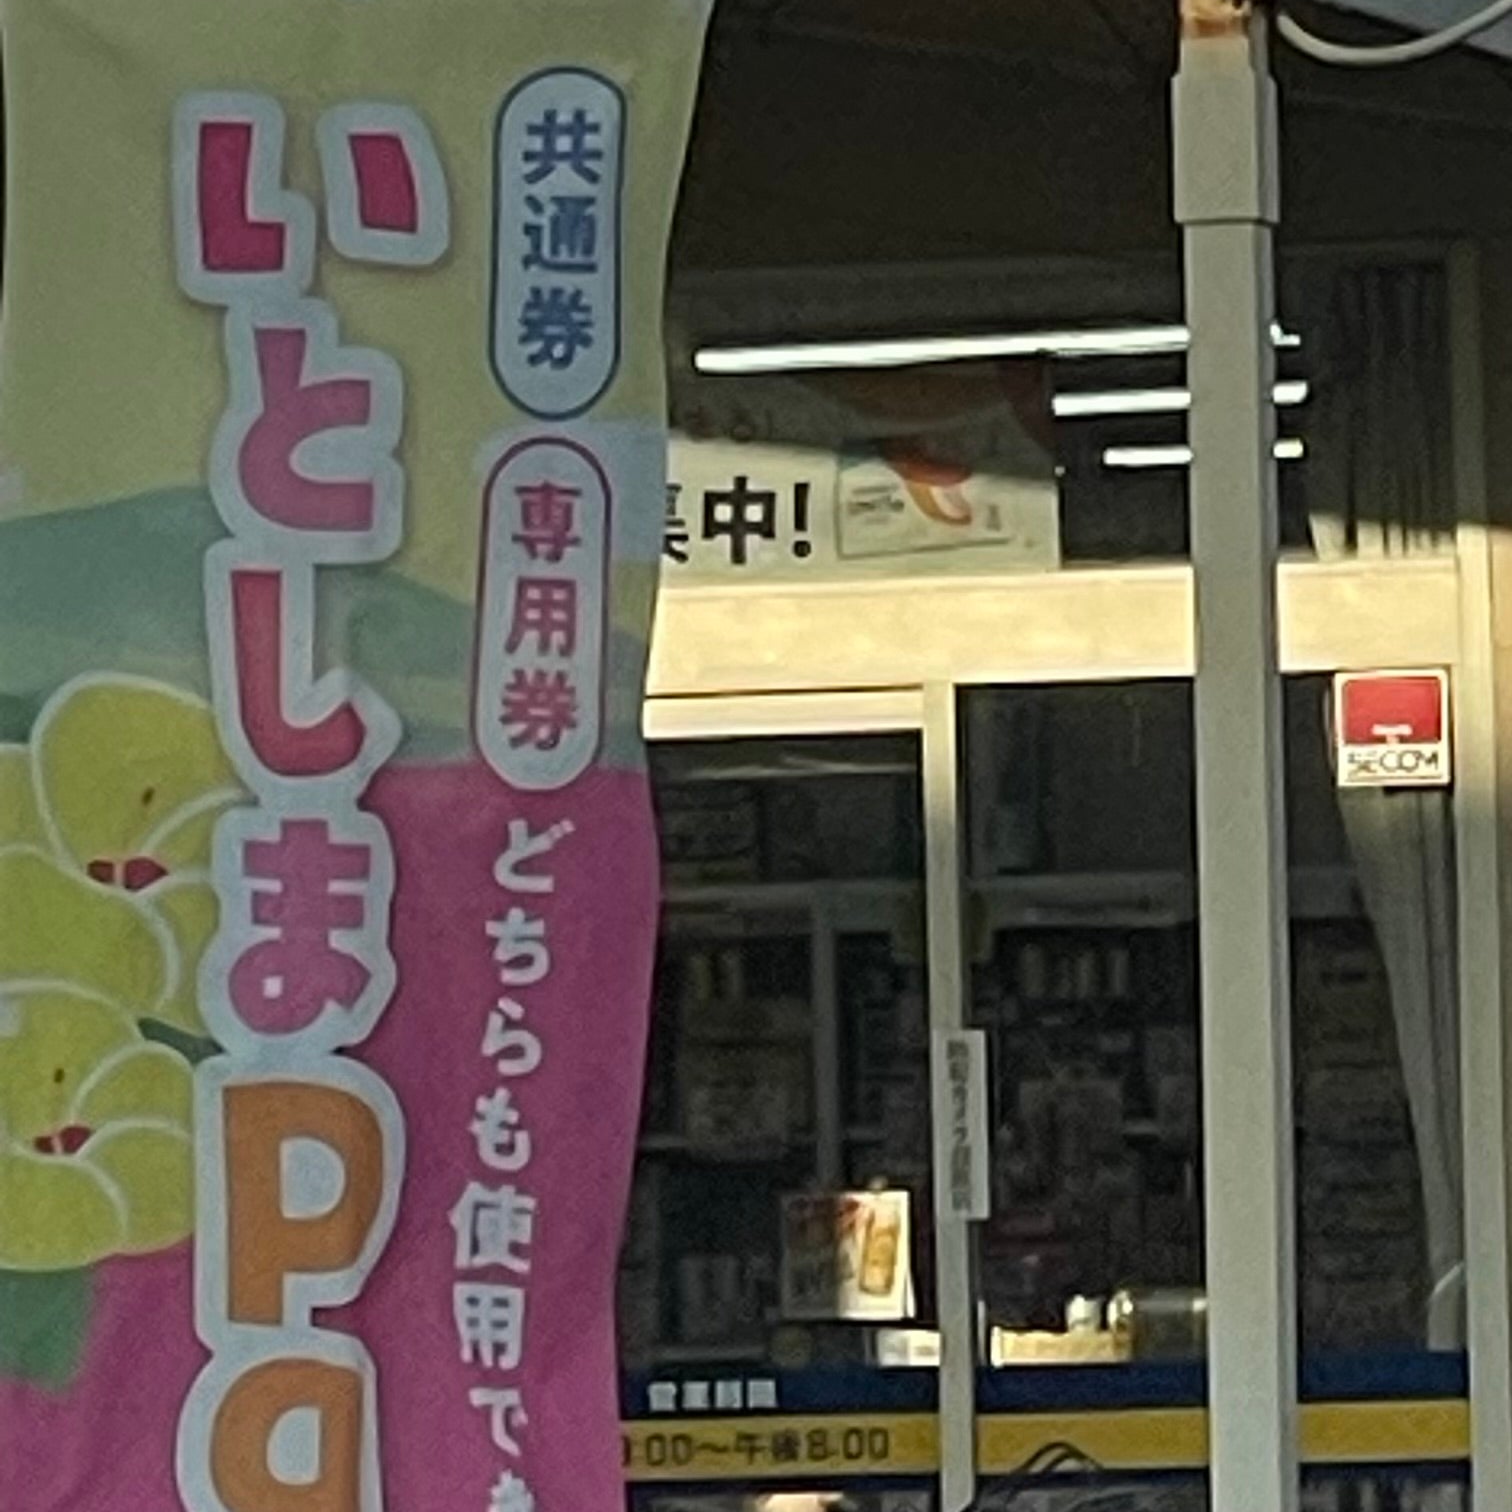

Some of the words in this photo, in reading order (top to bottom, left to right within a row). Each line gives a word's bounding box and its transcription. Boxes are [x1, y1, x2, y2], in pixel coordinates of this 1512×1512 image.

[520, 108, 603, 370] 共通券
[499, 481, 583, 752] 専用券
[1346, 749, 1439, 775] SECOM
